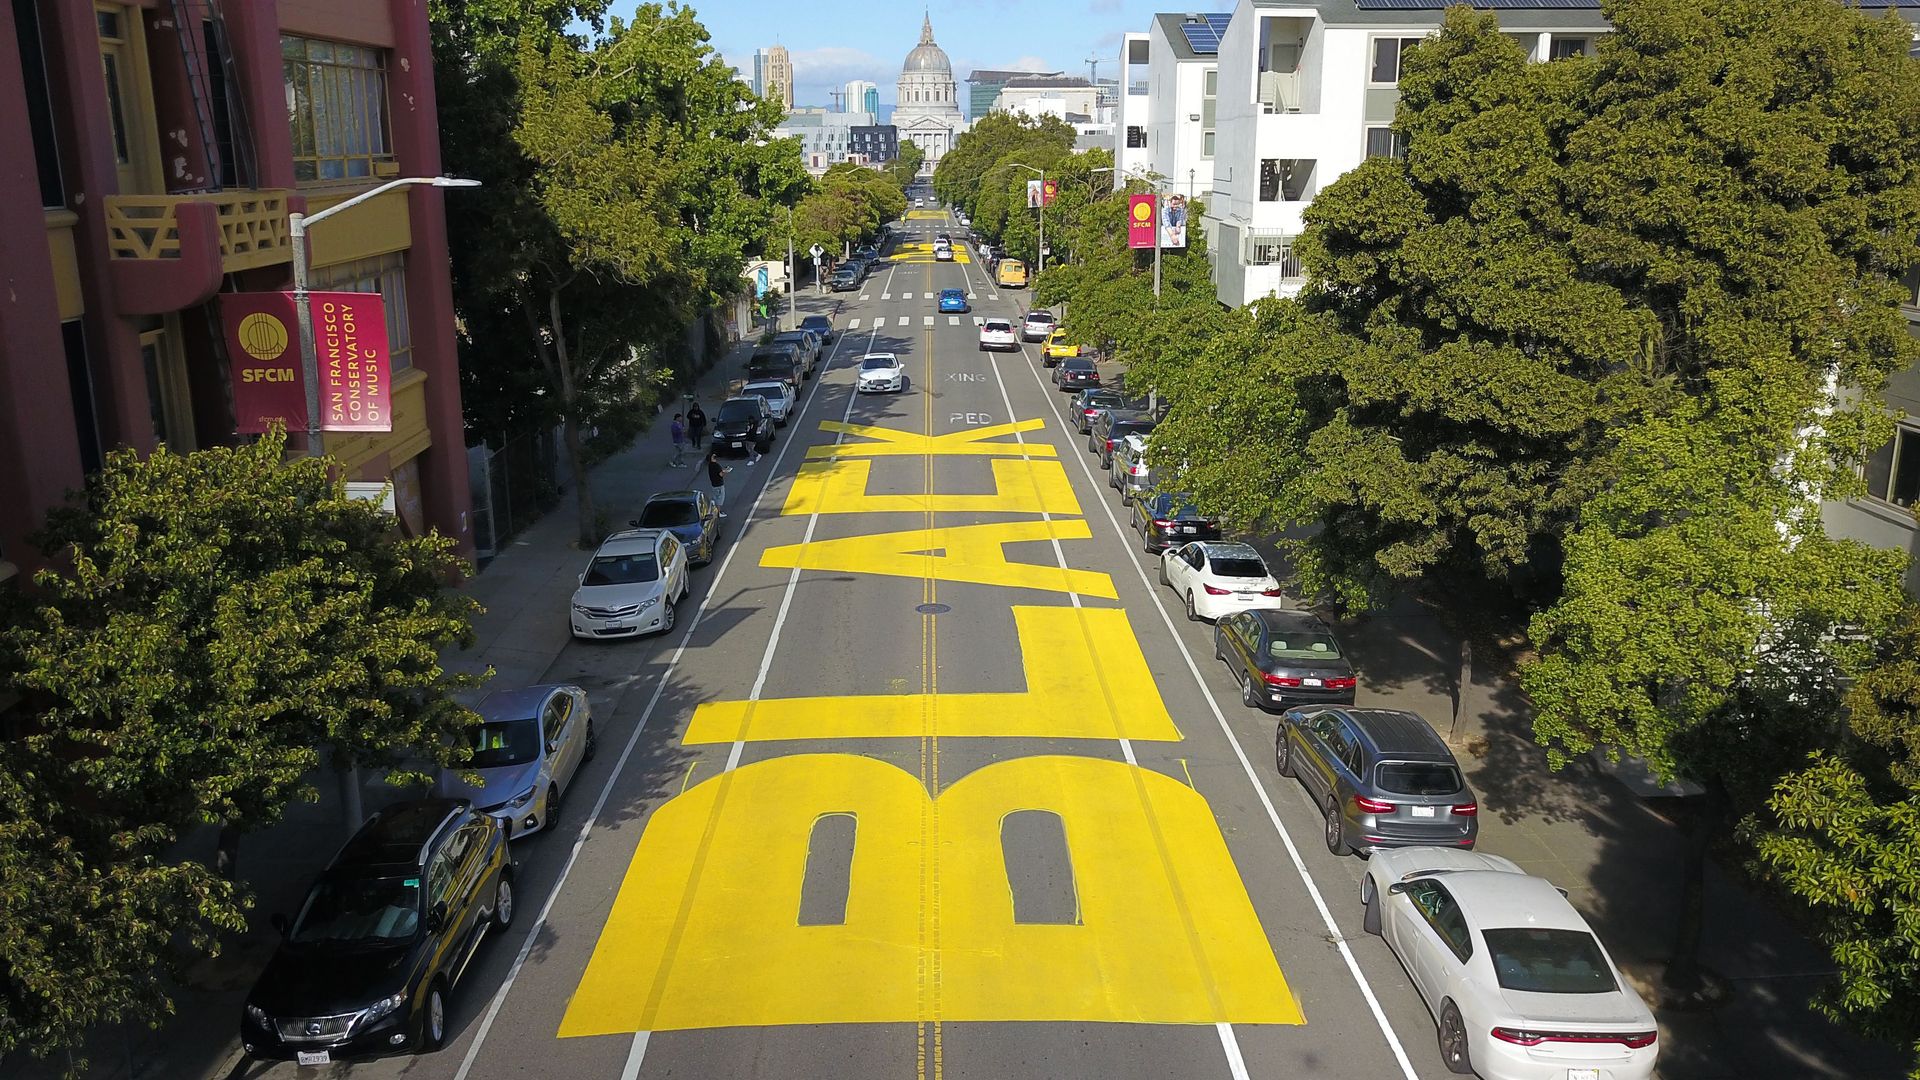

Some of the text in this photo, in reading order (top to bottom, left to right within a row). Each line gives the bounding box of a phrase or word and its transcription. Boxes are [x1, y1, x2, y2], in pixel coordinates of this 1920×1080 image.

[241, 368, 295, 383] SFCM
[323, 302, 343, 421] SAN FRANCISCO
[341, 304, 361, 421] CONSERVATORY
[364, 350, 380, 421] OF MUSIC
[944, 373, 986, 382] XING
[950, 412, 992, 424] PED
[557, 418, 1307, 1038] BLACK
